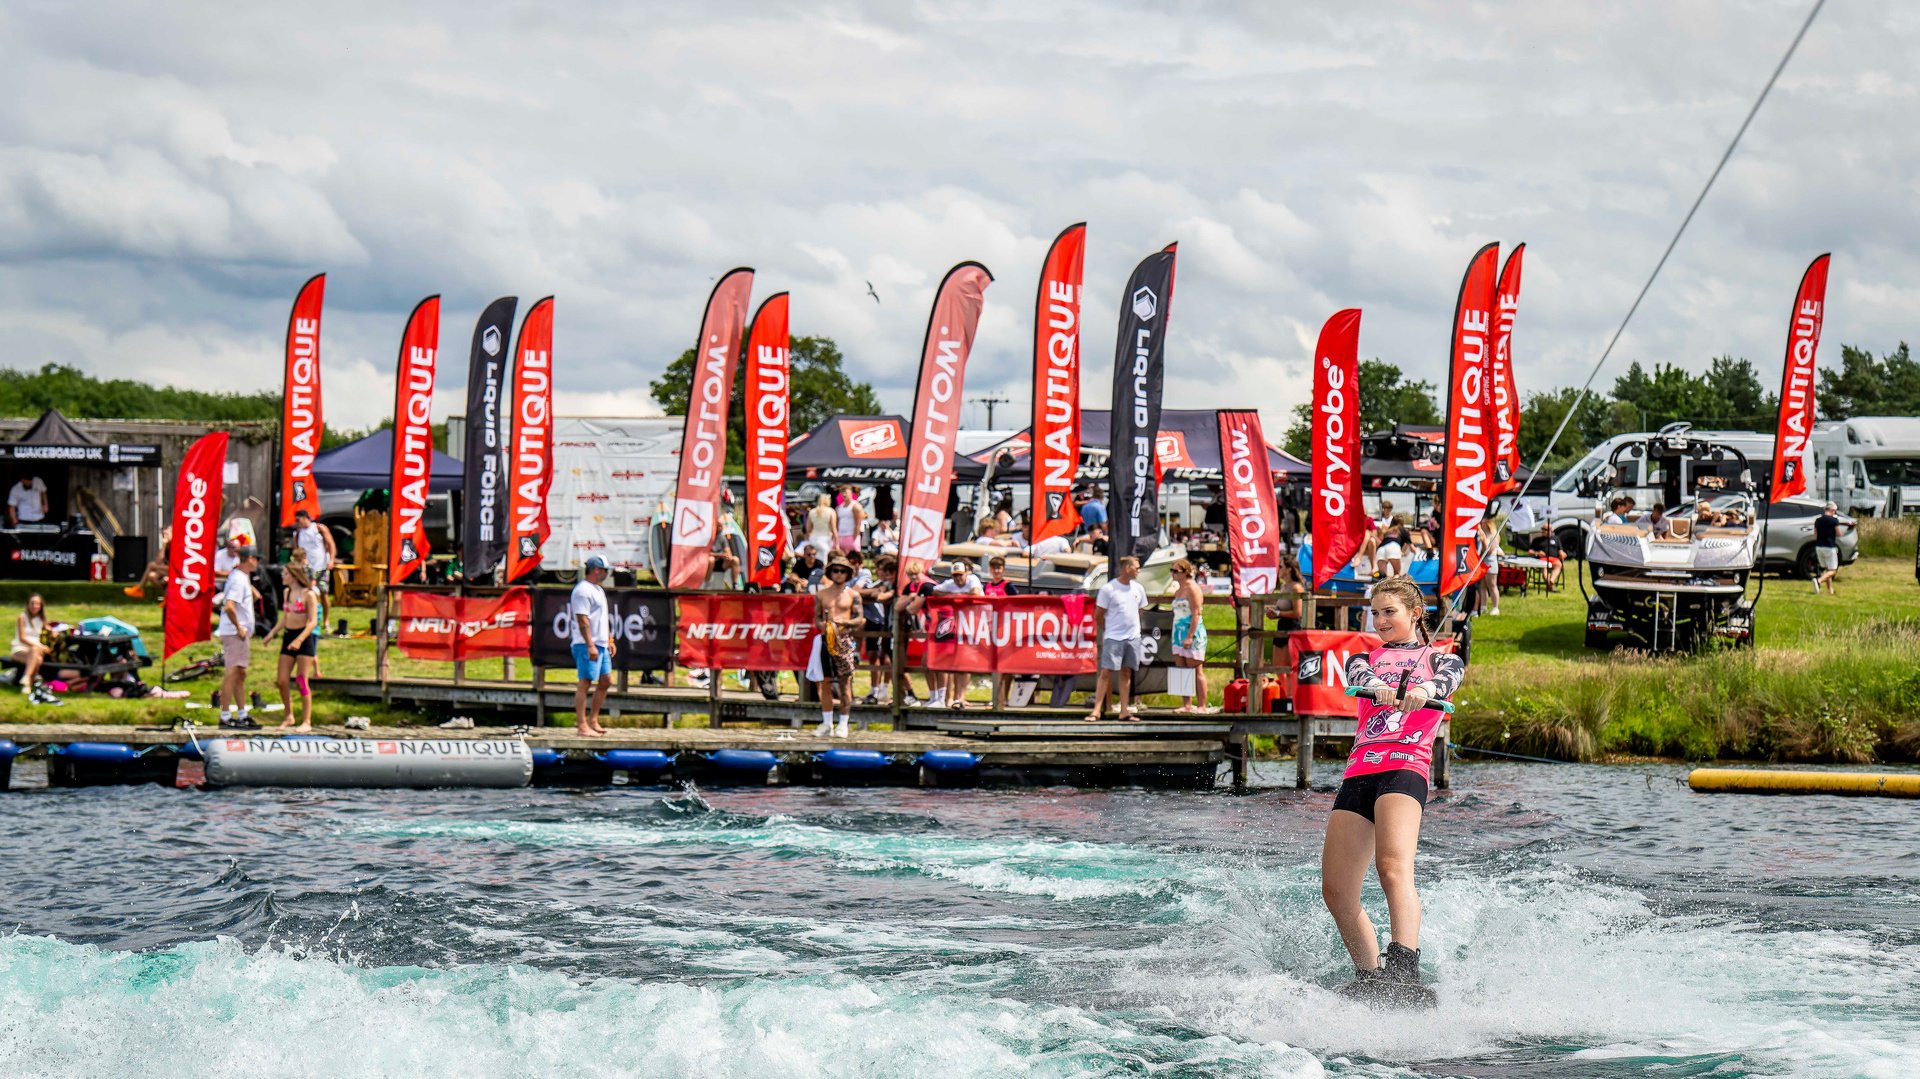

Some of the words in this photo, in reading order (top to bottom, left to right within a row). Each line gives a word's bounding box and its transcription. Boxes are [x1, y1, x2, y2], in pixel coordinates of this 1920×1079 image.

[291, 318, 317, 478] NAUTIQUE
[482, 362, 498, 447] LIQUID
[1045, 280, 1075, 487] NAUTIQUE
[1132, 328, 1150, 429] LIQUID
[1455, 309, 1488, 539] NAUTIQUE
[1783, 299, 1818, 458] NAUTIQUE
[14, 446, 86, 459] WAKEBOARD
[86, 448, 103, 460] UK
[399, 346, 433, 534] NAUTIQUE
[517, 349, 548, 532] NAUTIQUE
[757, 345, 786, 541] NAUTIQUE
[822, 467, 905, 479] NAUTIQ
[1131, 436, 1148, 537] FORCE
[1232, 423, 1268, 556] FOLLOW.
[481, 454, 496, 542] FORCE
[20, 549, 76, 565] NAUTIQUE
[687, 623, 812, 642] NAUTIQUE
[957, 609, 1094, 650] NAUTIQUE
[249, 741, 372, 755] NAUTIQUE
[400, 742, 523, 756] NAUTIQUE
